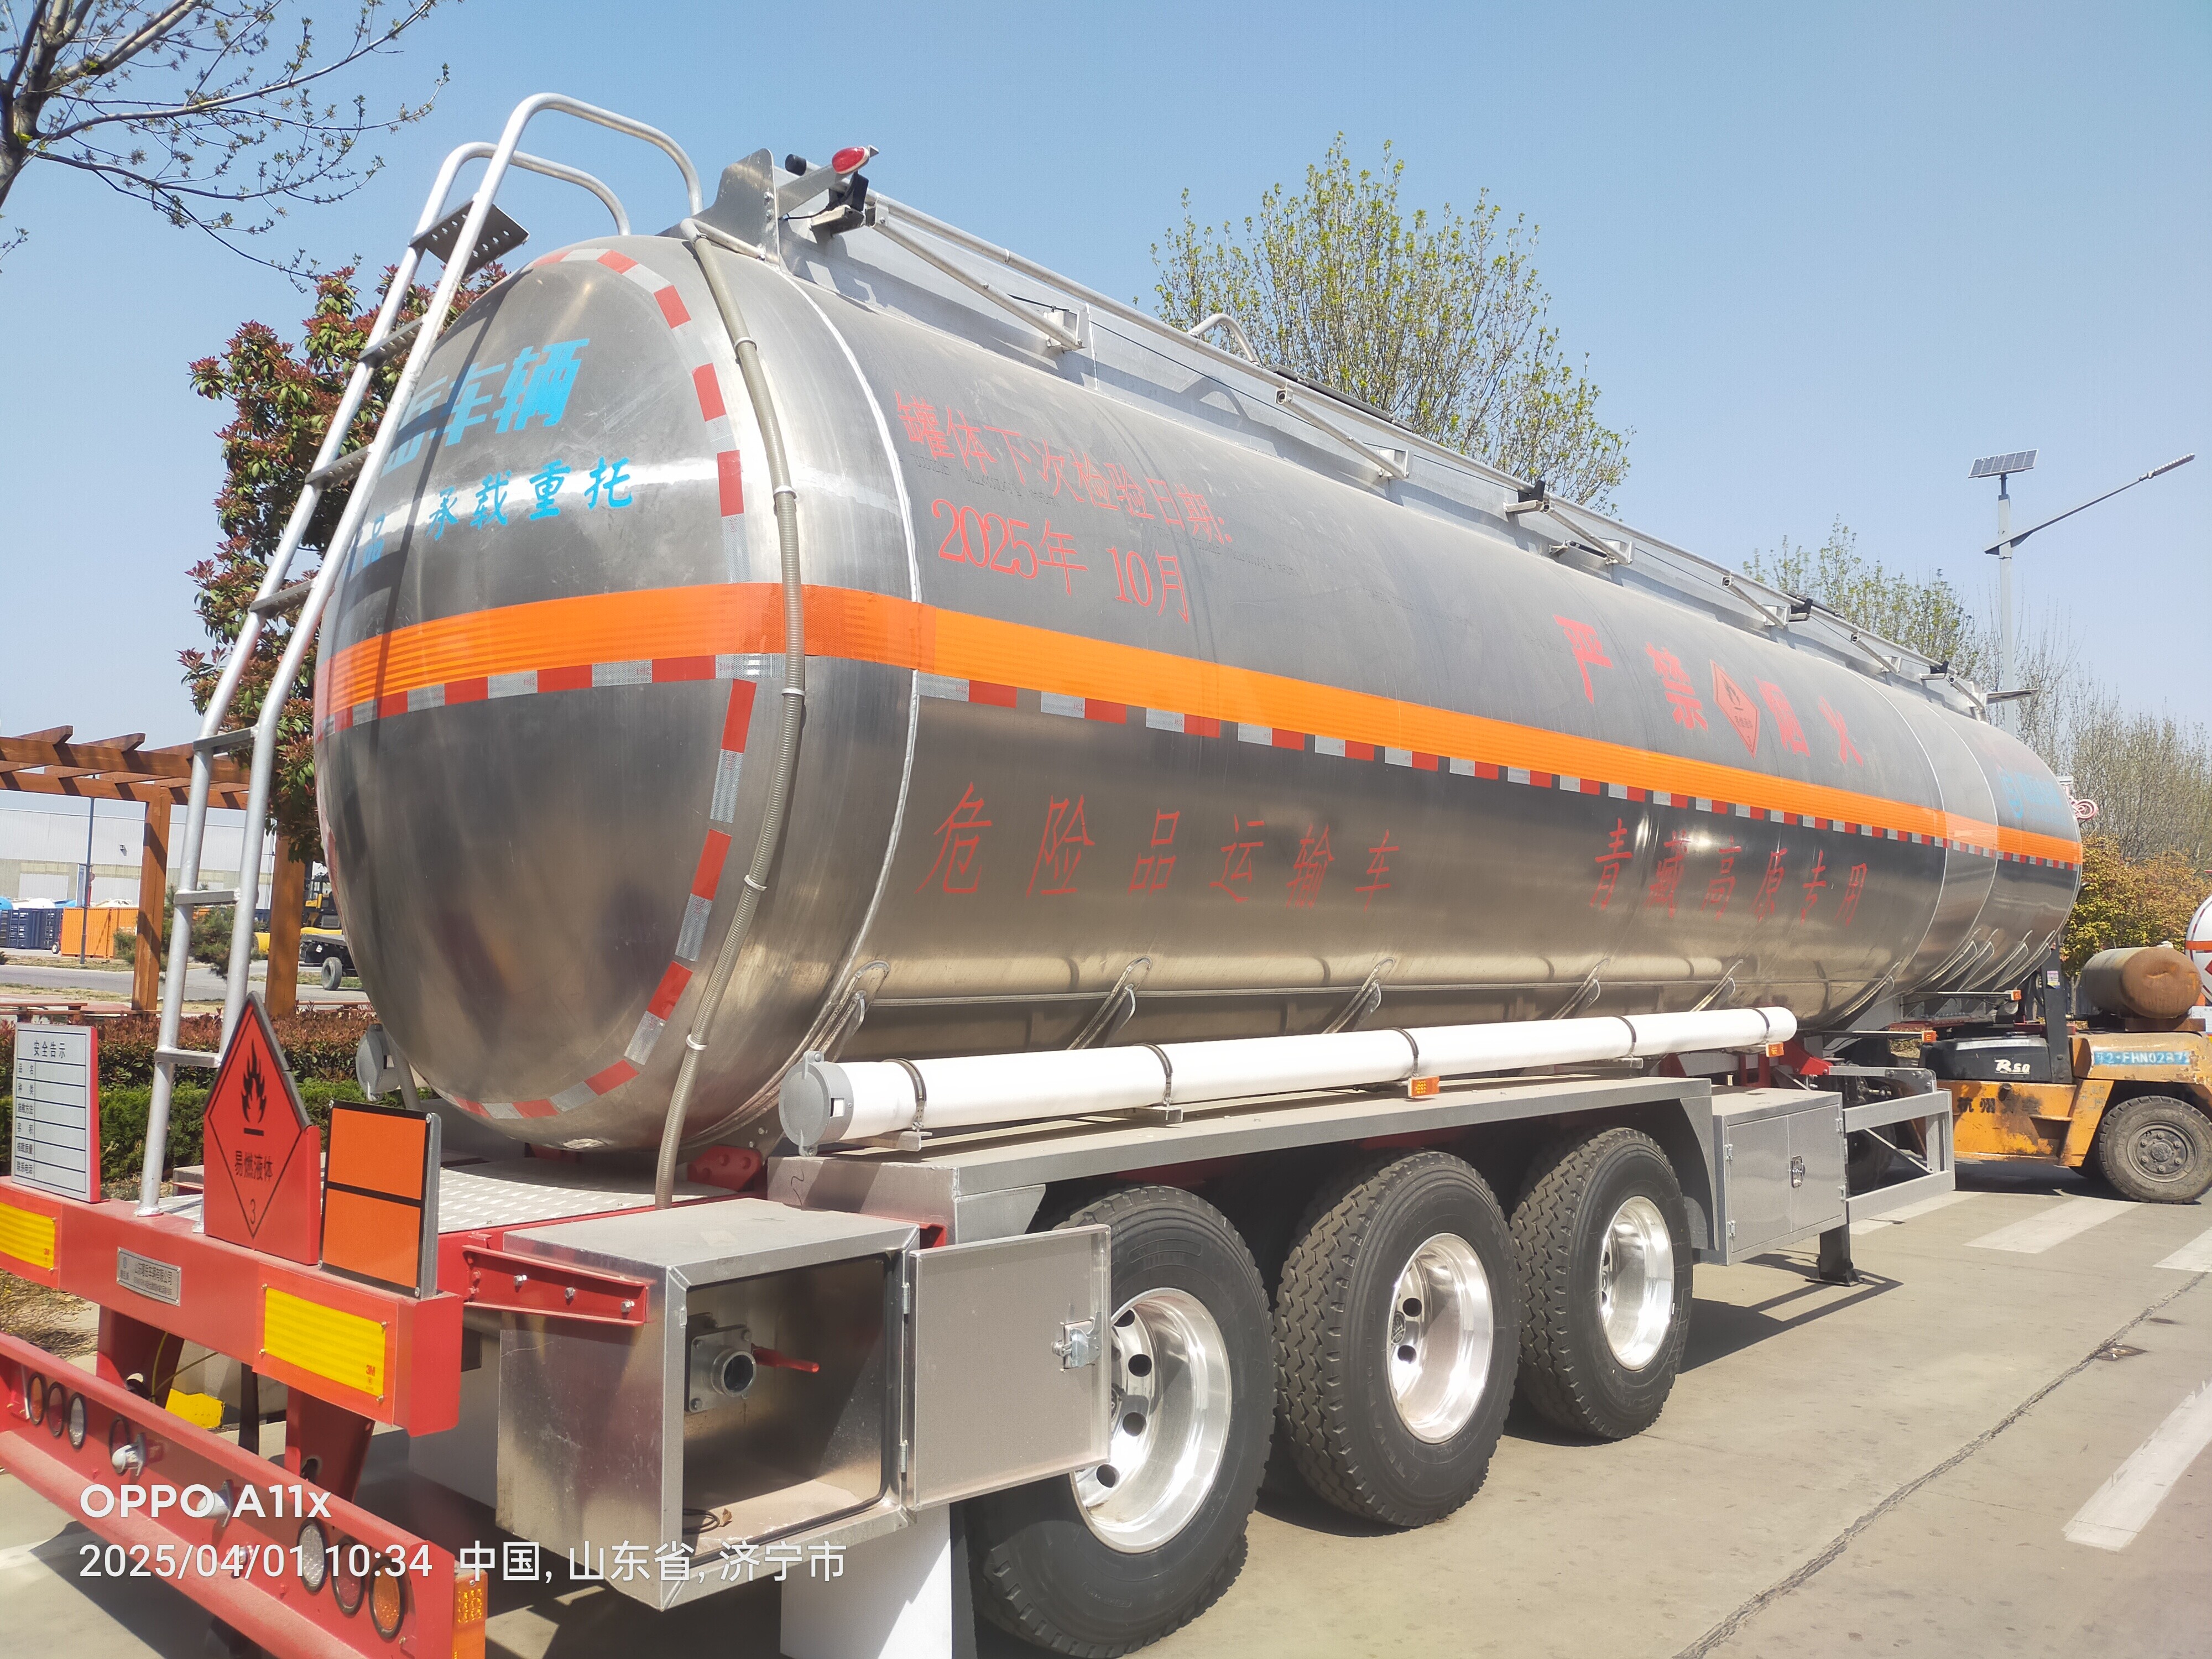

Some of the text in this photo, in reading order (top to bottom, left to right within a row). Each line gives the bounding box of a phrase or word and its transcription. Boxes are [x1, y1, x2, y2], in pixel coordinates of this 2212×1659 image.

[425, 456, 634, 541] 承载重托
[931, 499, 1088, 596] 2025年
[1106, 546, 1190, 624] 10月
[913, 781, 1401, 914] 危险品运输车
[1588, 817, 1867, 928] 青藏高原专用
[33, 1040, 66, 1059] 安全告示
[234, 1149, 273, 1182] 易燃液体
[249, 1198, 256, 1225] 3
